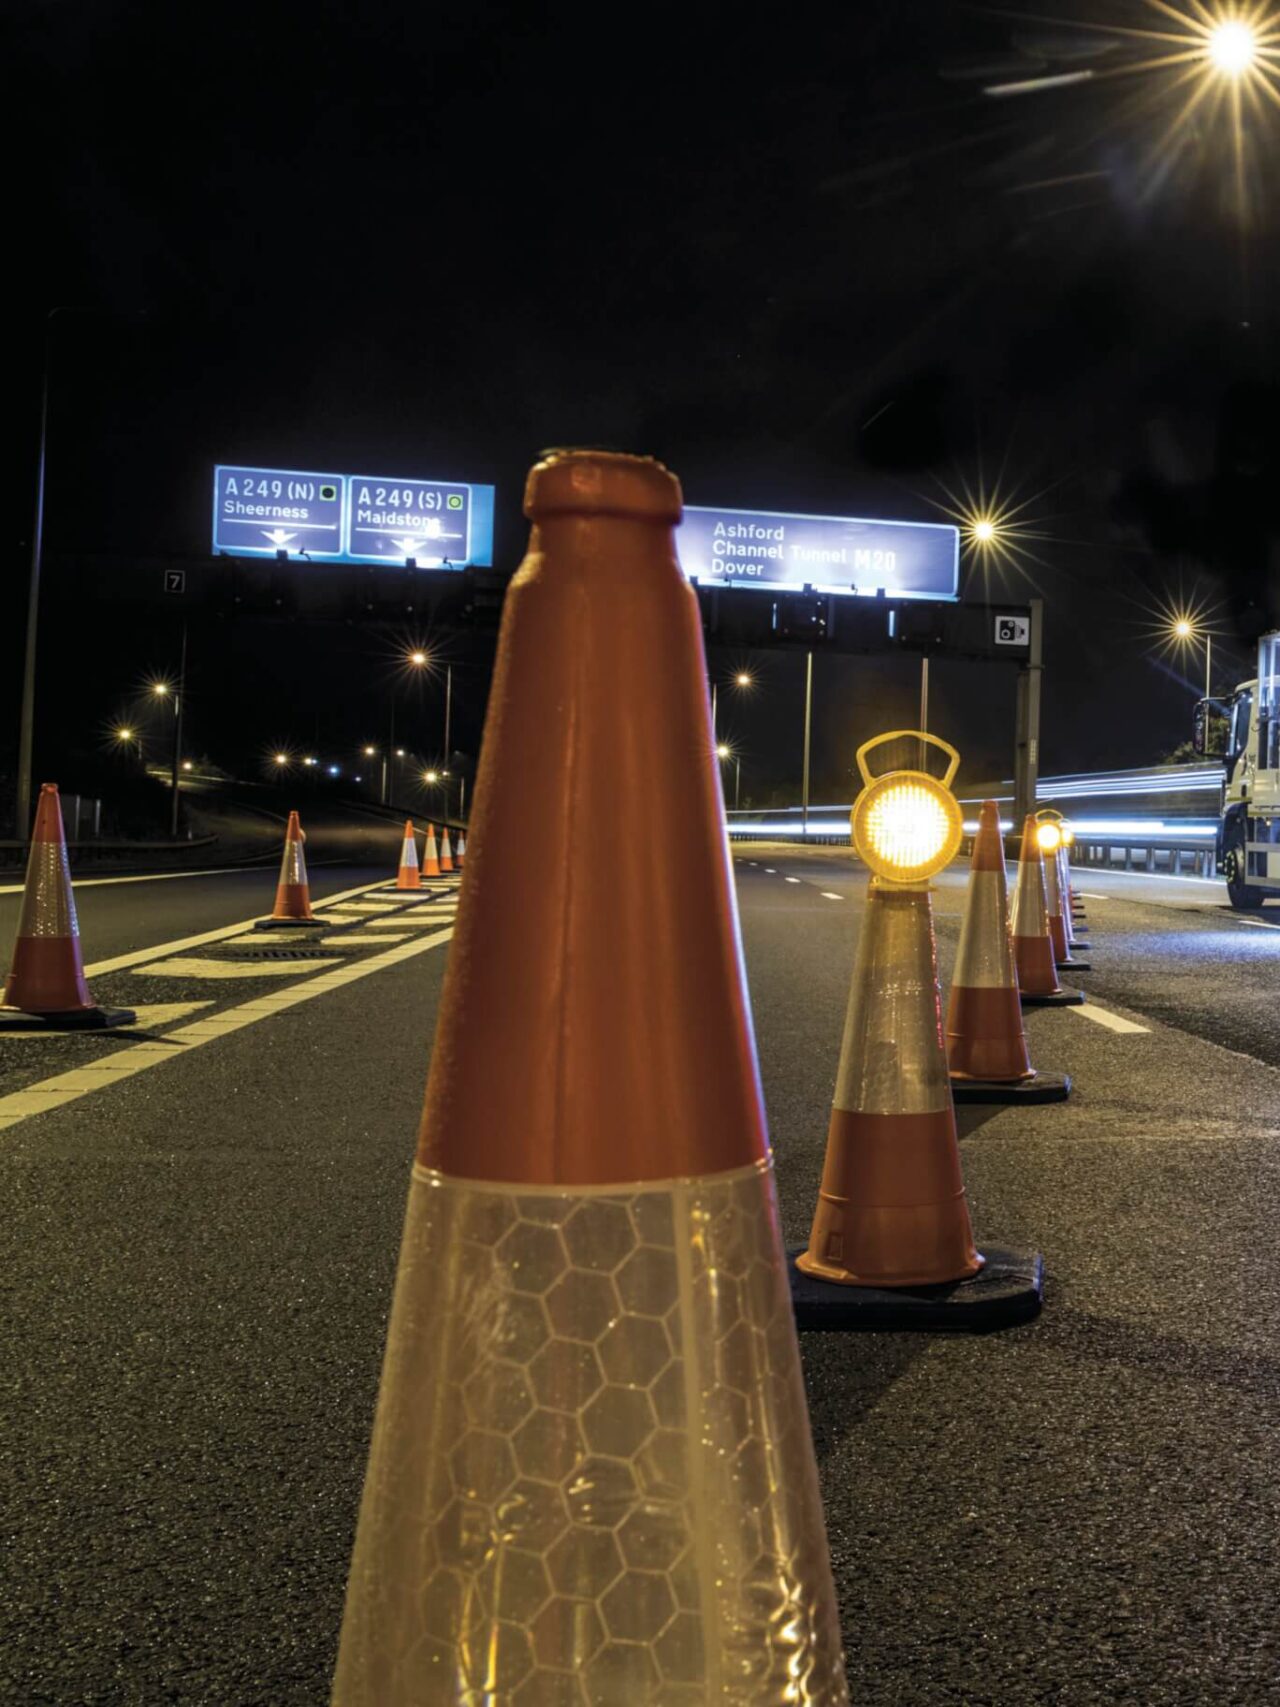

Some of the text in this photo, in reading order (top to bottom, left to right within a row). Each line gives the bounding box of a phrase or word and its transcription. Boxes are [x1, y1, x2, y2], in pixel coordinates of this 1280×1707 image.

[224, 500, 309, 519] Sheerness
[714, 522, 785, 541] Ashford
[713, 539, 896, 572] Channel Tunnel M20
[712, 558, 764, 576] Dover
[169, 575, 180, 589] 7
